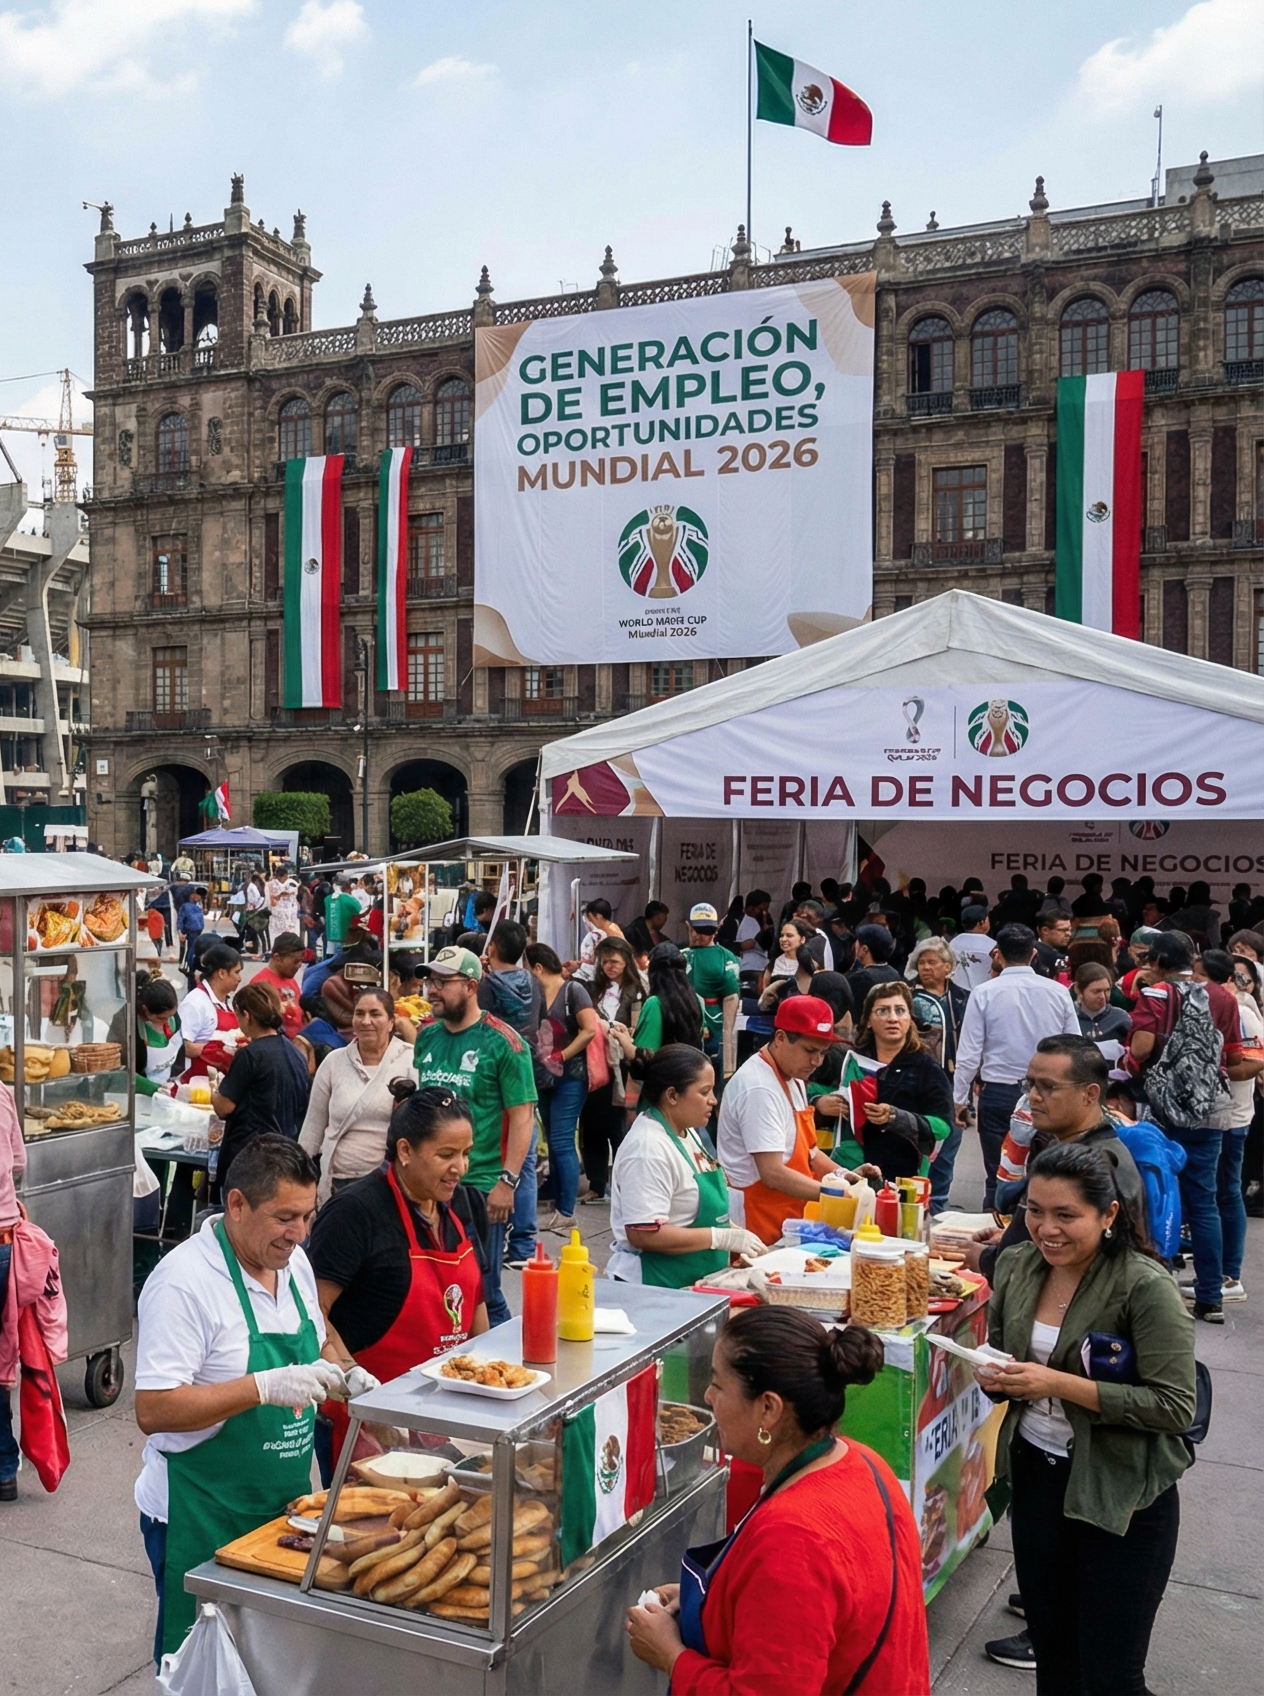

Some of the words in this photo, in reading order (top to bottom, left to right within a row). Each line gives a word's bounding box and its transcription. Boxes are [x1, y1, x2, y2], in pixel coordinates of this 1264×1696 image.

[518, 315, 818, 385] GENERACIÓN
[520, 386, 583, 426] DE
[599, 360, 826, 417] EMPLEO,
[516, 403, 819, 457] OPORTUNIDADES
[516, 448, 705, 492] MUNDIAL
[716, 437, 819, 476] 2026
[618, 617, 654, 628] WORLD
[687, 615, 707, 625] CUP
[669, 626, 698, 637] 2026
[723, 775, 856, 808] FERIA
[871, 775, 934, 808] DE
[951, 771, 1228, 808] NEGOCIOS
[990, 852, 1068, 872] FERIA
[1075, 853, 1112, 873] DE
